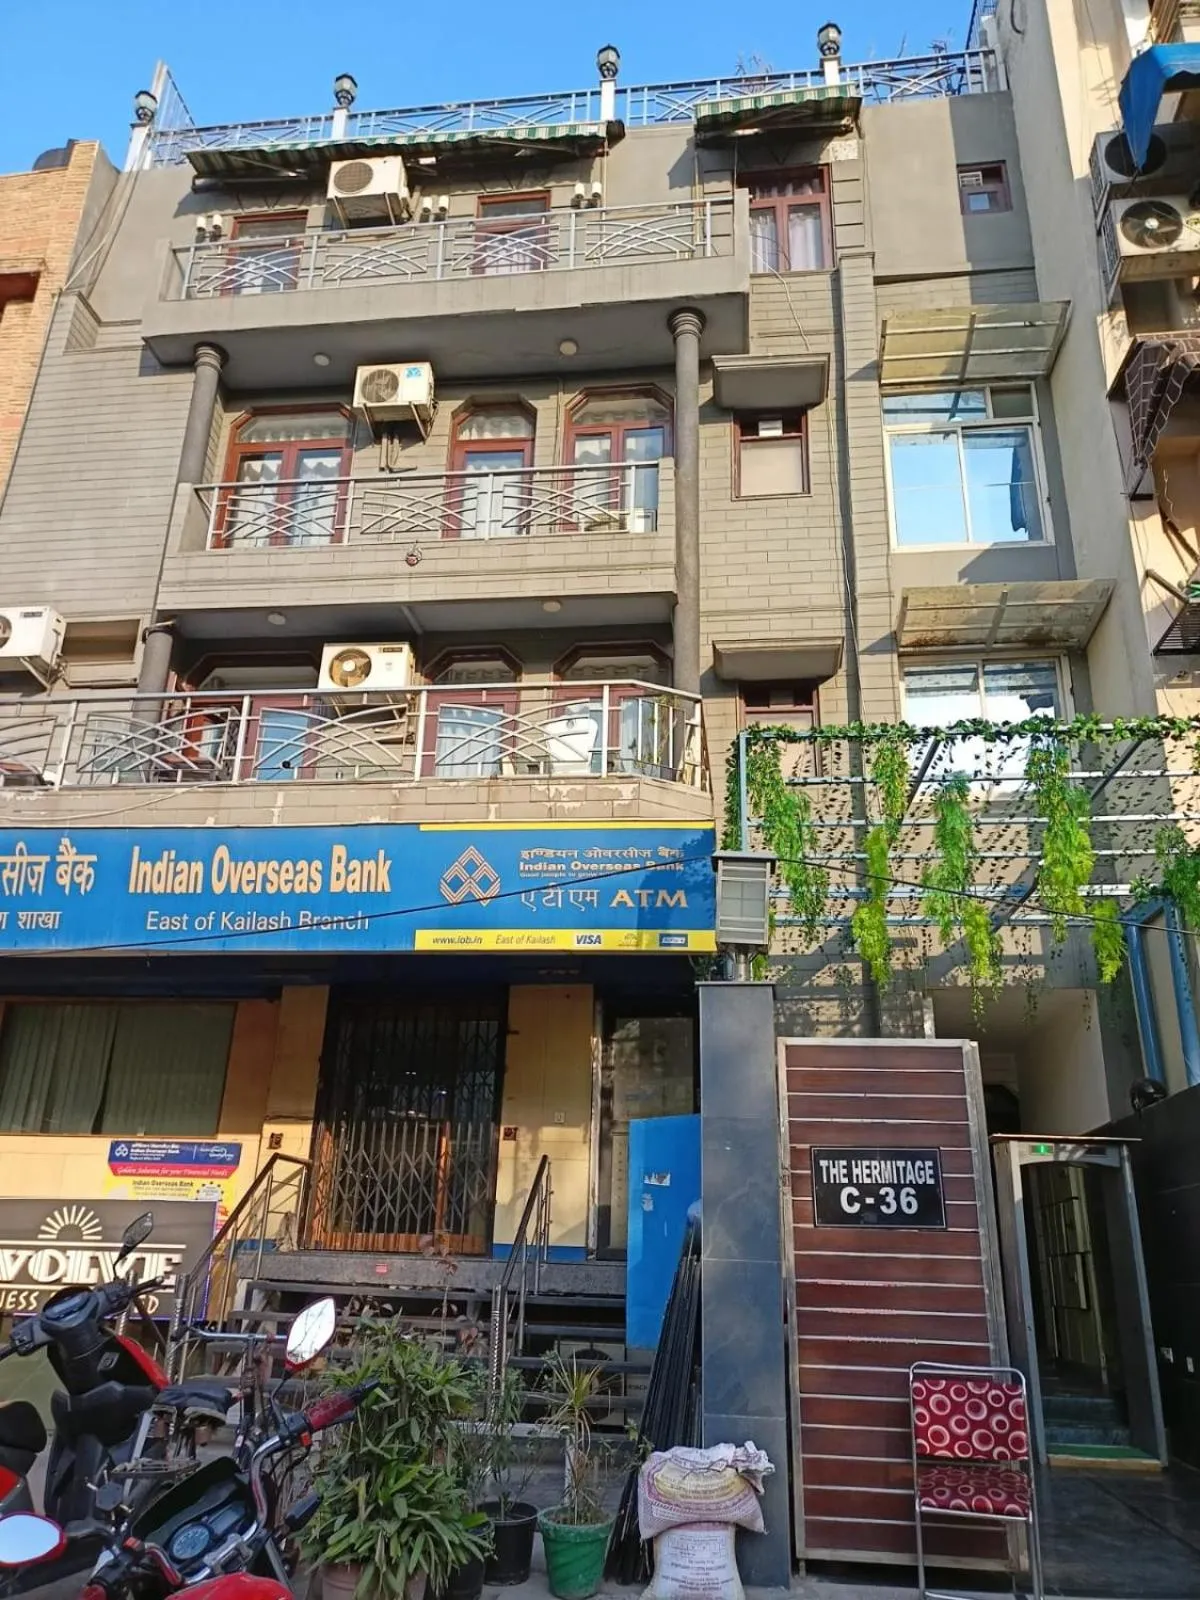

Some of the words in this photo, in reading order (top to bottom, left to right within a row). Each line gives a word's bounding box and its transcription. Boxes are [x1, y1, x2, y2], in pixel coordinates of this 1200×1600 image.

[128, 846, 204, 894] Indian
[210, 844, 322, 895] Overseas
[330, 844, 392, 894] Bank
[519, 862, 566, 871] Indian
[571, 861, 641, 871] Overseas
[645, 860, 684, 871] Bank
[609, 889, 688, 908] ATM
[17, 911, 63, 930] शाखा
[147, 911, 188, 930] East
[194, 910, 215, 930] of
[220, 911, 291, 931] Kailash
[299, 912, 369, 931] Branch
[432, 935, 483, 944] www.iob.in
[495, 935, 513, 944] East
[515, 935, 525, 944] of
[526, 935, 556, 944] Kailash
[576, 935, 602, 945] VISA
[819, 1160, 849, 1184] THE
[852, 1160, 935, 1185] HERMITAGE
